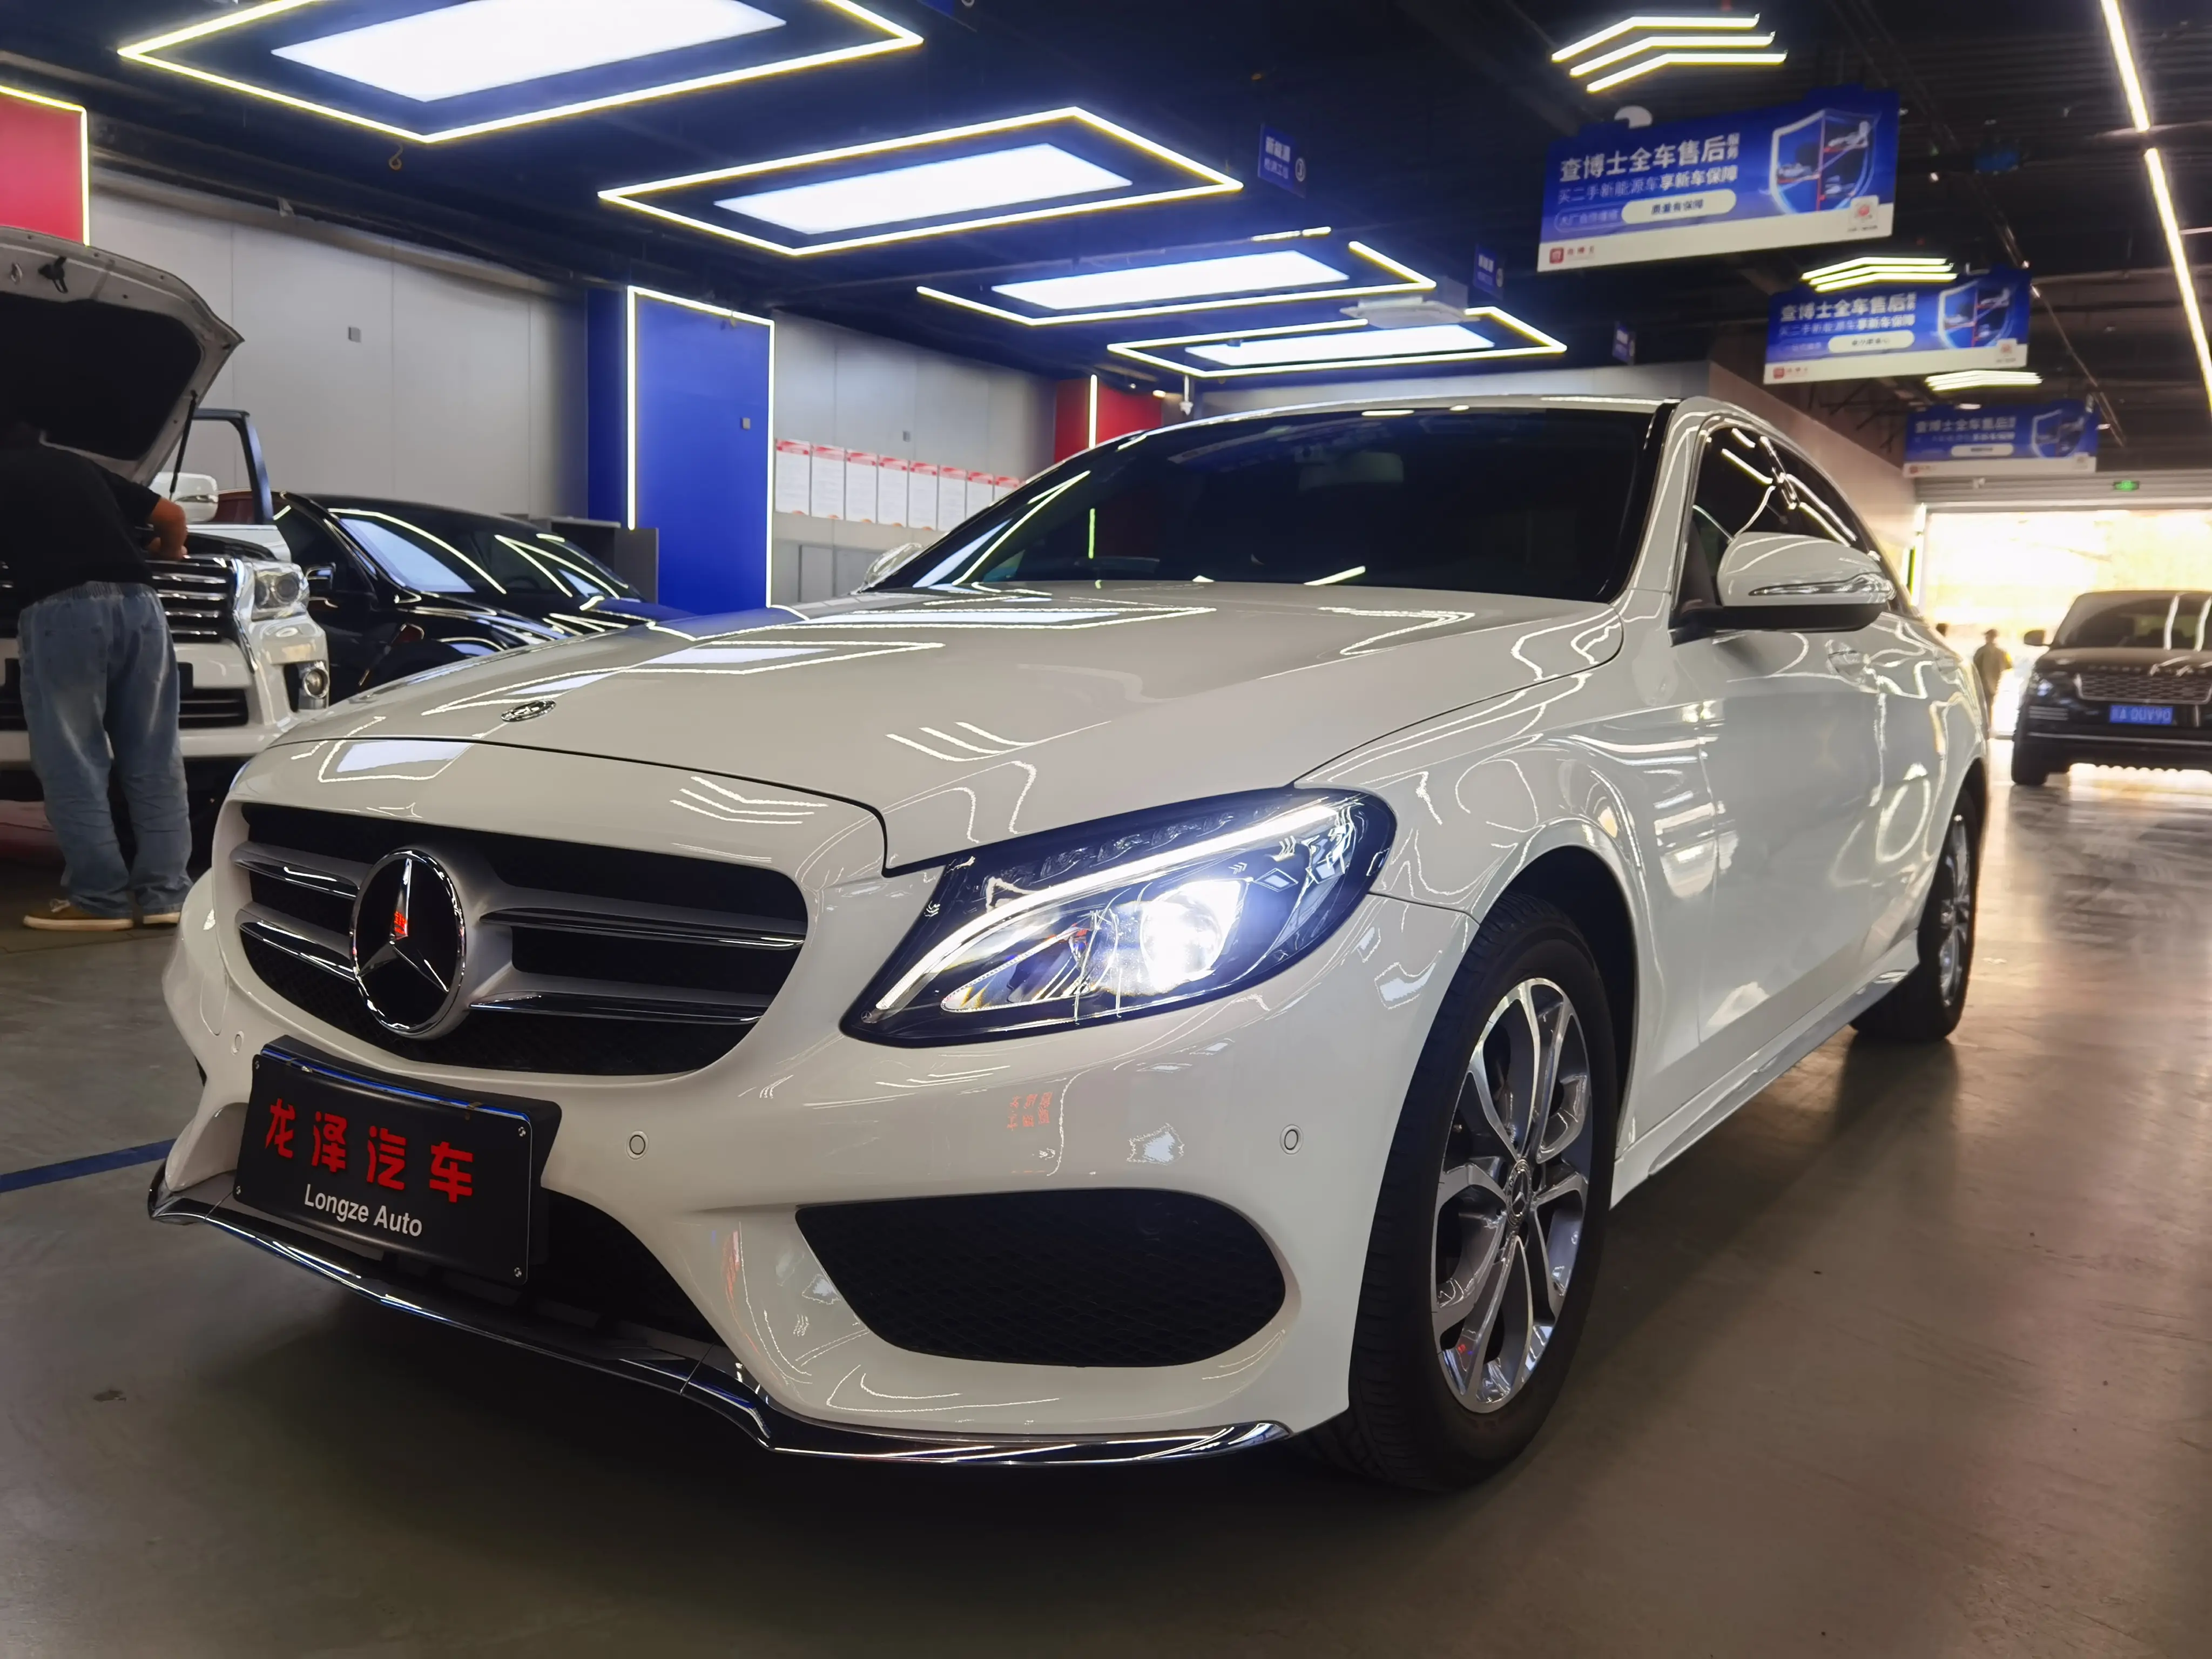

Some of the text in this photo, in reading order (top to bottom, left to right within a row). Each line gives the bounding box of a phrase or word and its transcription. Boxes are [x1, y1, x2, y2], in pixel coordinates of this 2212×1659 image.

[266, 1098, 473, 1203] 龙泽汽车
[304, 1184, 423, 1237] Longze Auto
